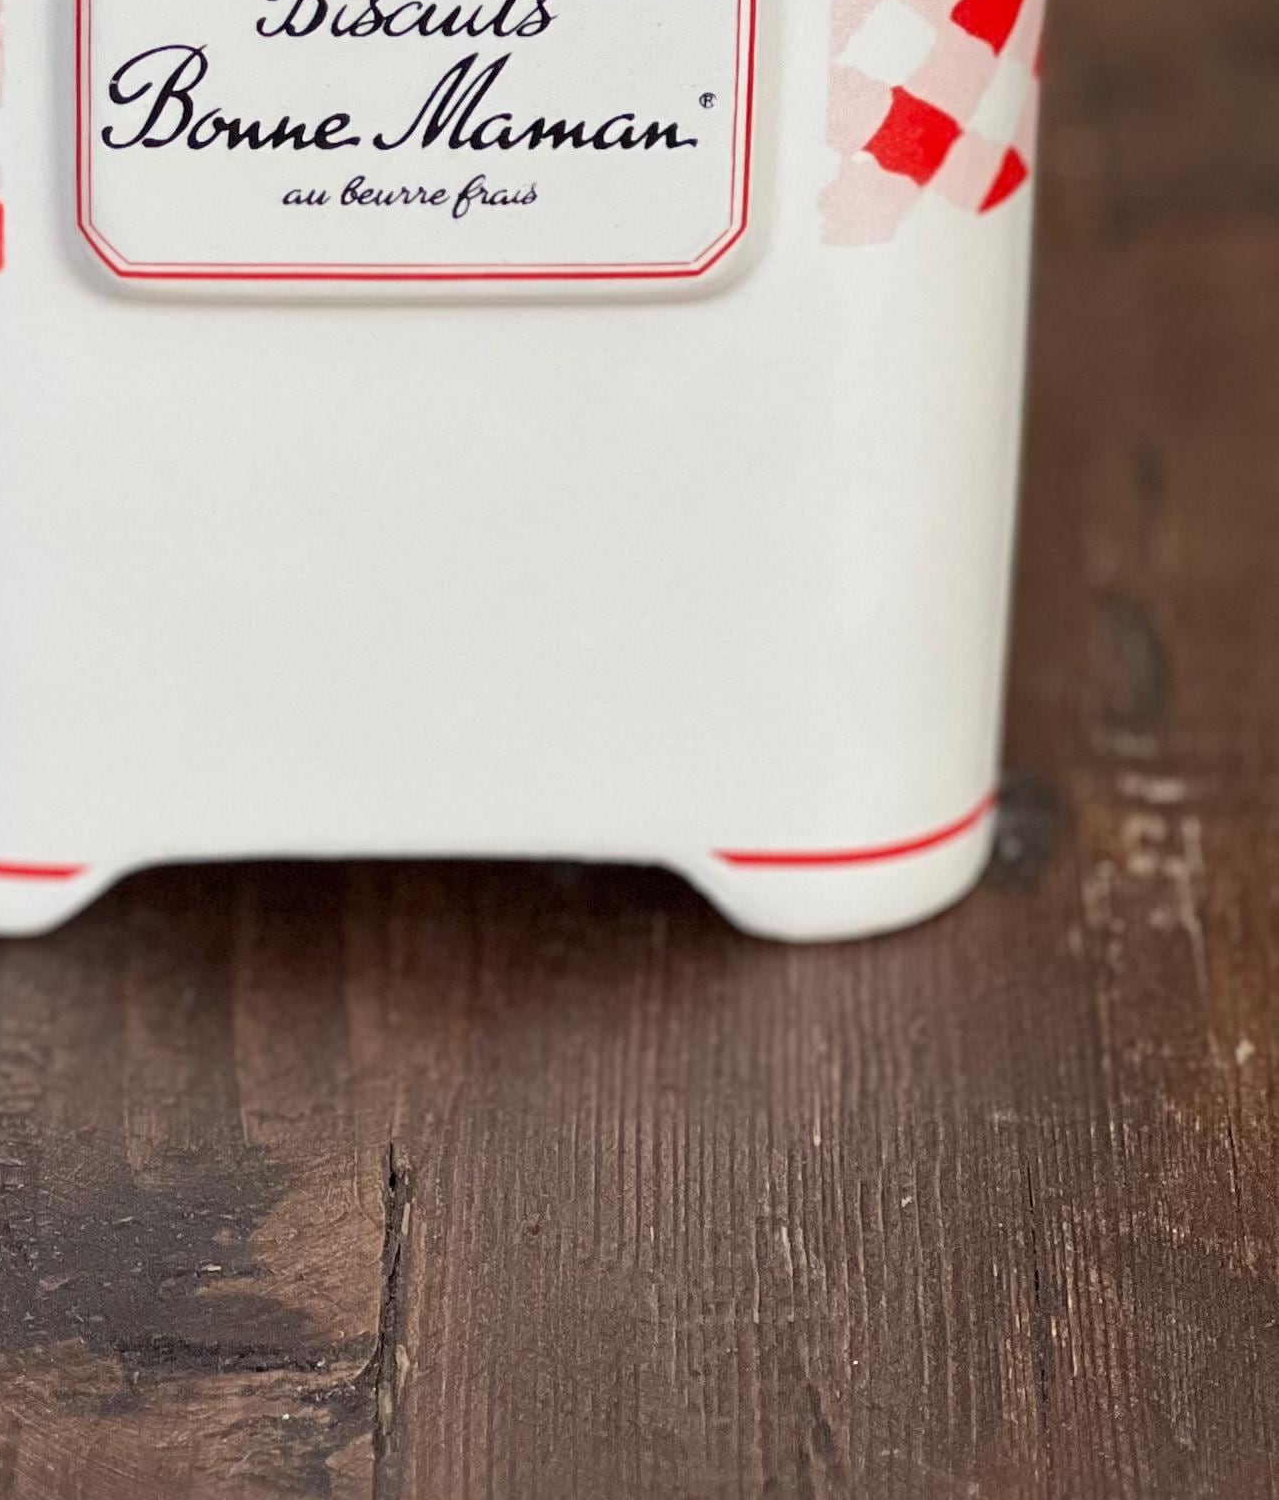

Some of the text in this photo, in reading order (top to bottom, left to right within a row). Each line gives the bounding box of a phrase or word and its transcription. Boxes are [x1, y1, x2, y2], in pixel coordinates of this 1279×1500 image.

[101, 44, 361, 150] Bonne
[281, 174, 540, 219] au beurre frais
